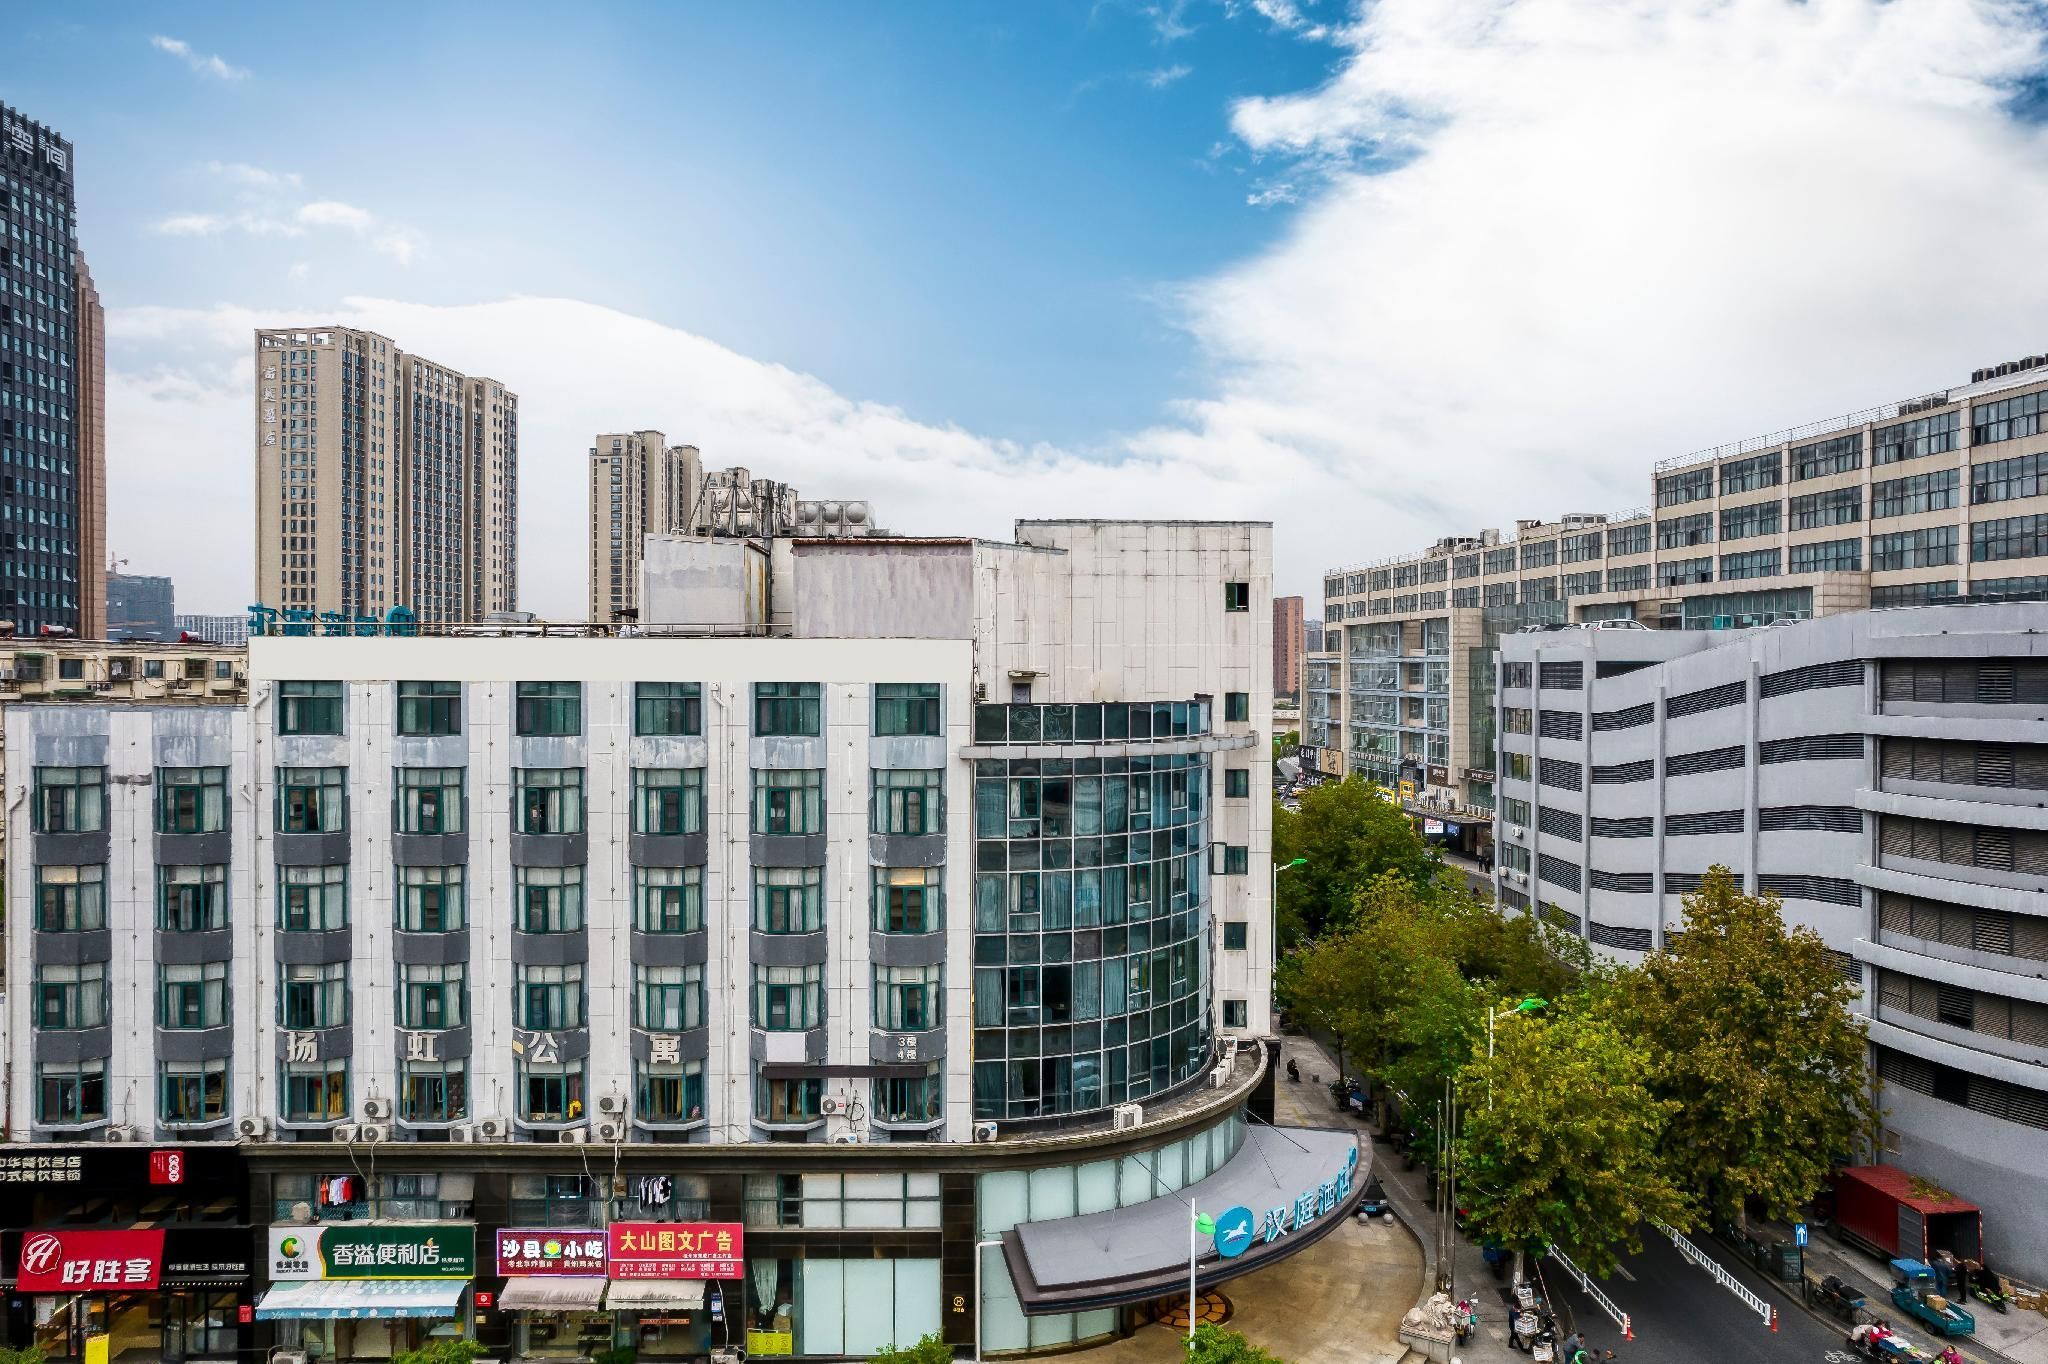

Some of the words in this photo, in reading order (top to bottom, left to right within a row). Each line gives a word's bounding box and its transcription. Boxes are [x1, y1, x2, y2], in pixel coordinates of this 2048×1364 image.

[1264, 1164, 1351, 1243] 汉庭酒店
[502, 1240, 541, 1259] 沙县
[563, 1240, 604, 1259] 小吃
[620, 1230, 733, 1252] 大山图文广告
[332, 1243, 440, 1266] 香溢便利店
[61, 1258, 152, 1284] 好胜客
